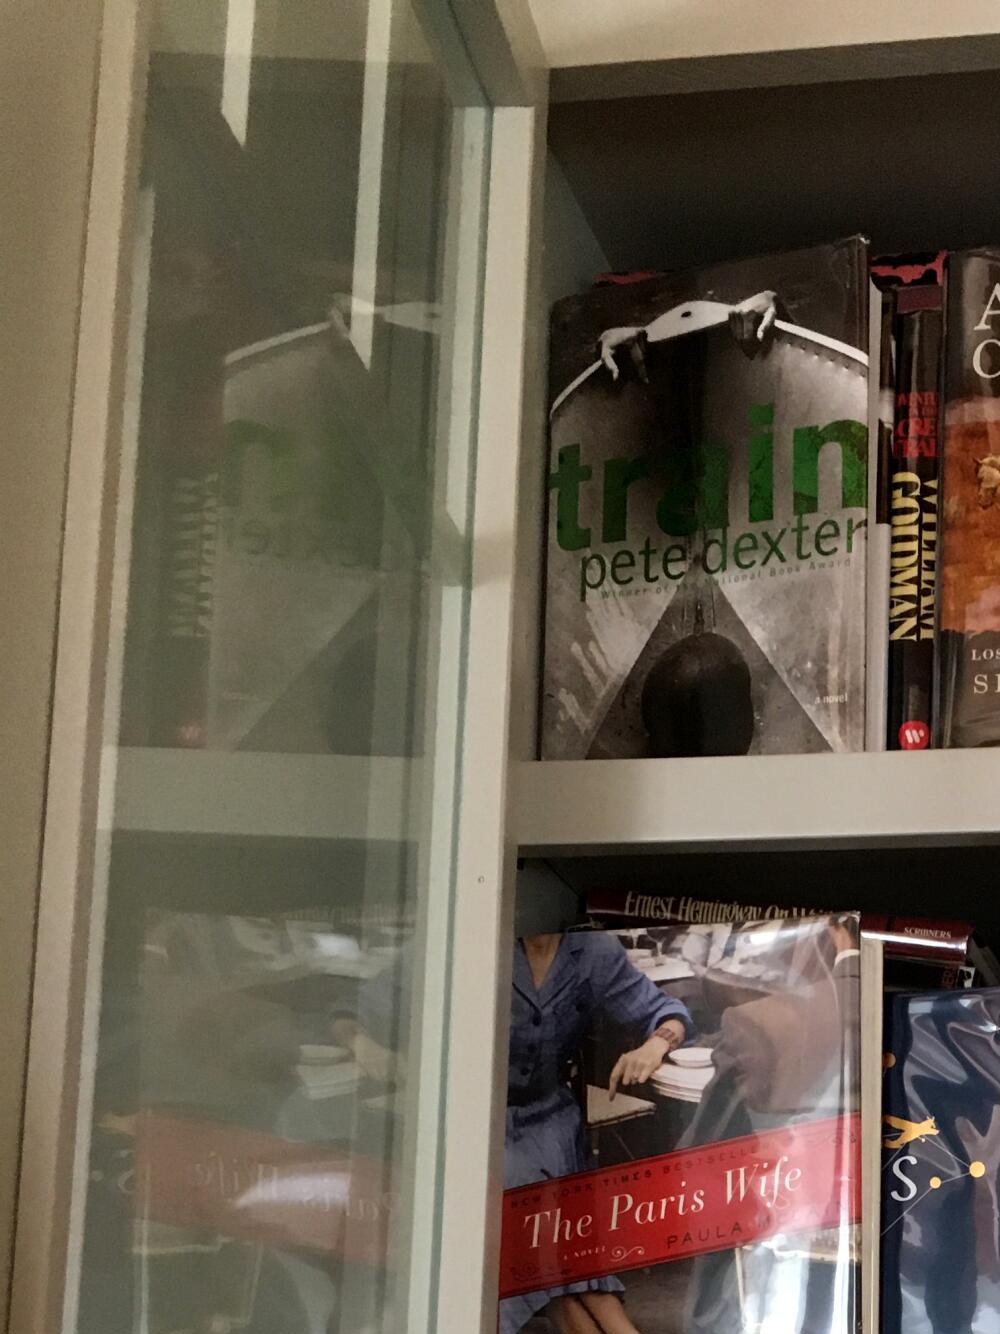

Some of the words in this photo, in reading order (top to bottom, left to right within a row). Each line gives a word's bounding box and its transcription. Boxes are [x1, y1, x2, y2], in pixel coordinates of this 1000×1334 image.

[550, 400, 868, 550] train
[580, 537, 688, 602] pete
[702, 518, 868, 576] dexter
[889, 472, 922, 642] GOLDMAN
[677, 896, 761, 923] Hemingway
[904, 927, 952, 939] SCRIBNERS
[523, 1208, 594, 1250] The
[608, 1181, 706, 1232] Paris
[723, 1155, 803, 1209] Wife
[666, 1221, 744, 1250] PAULA
